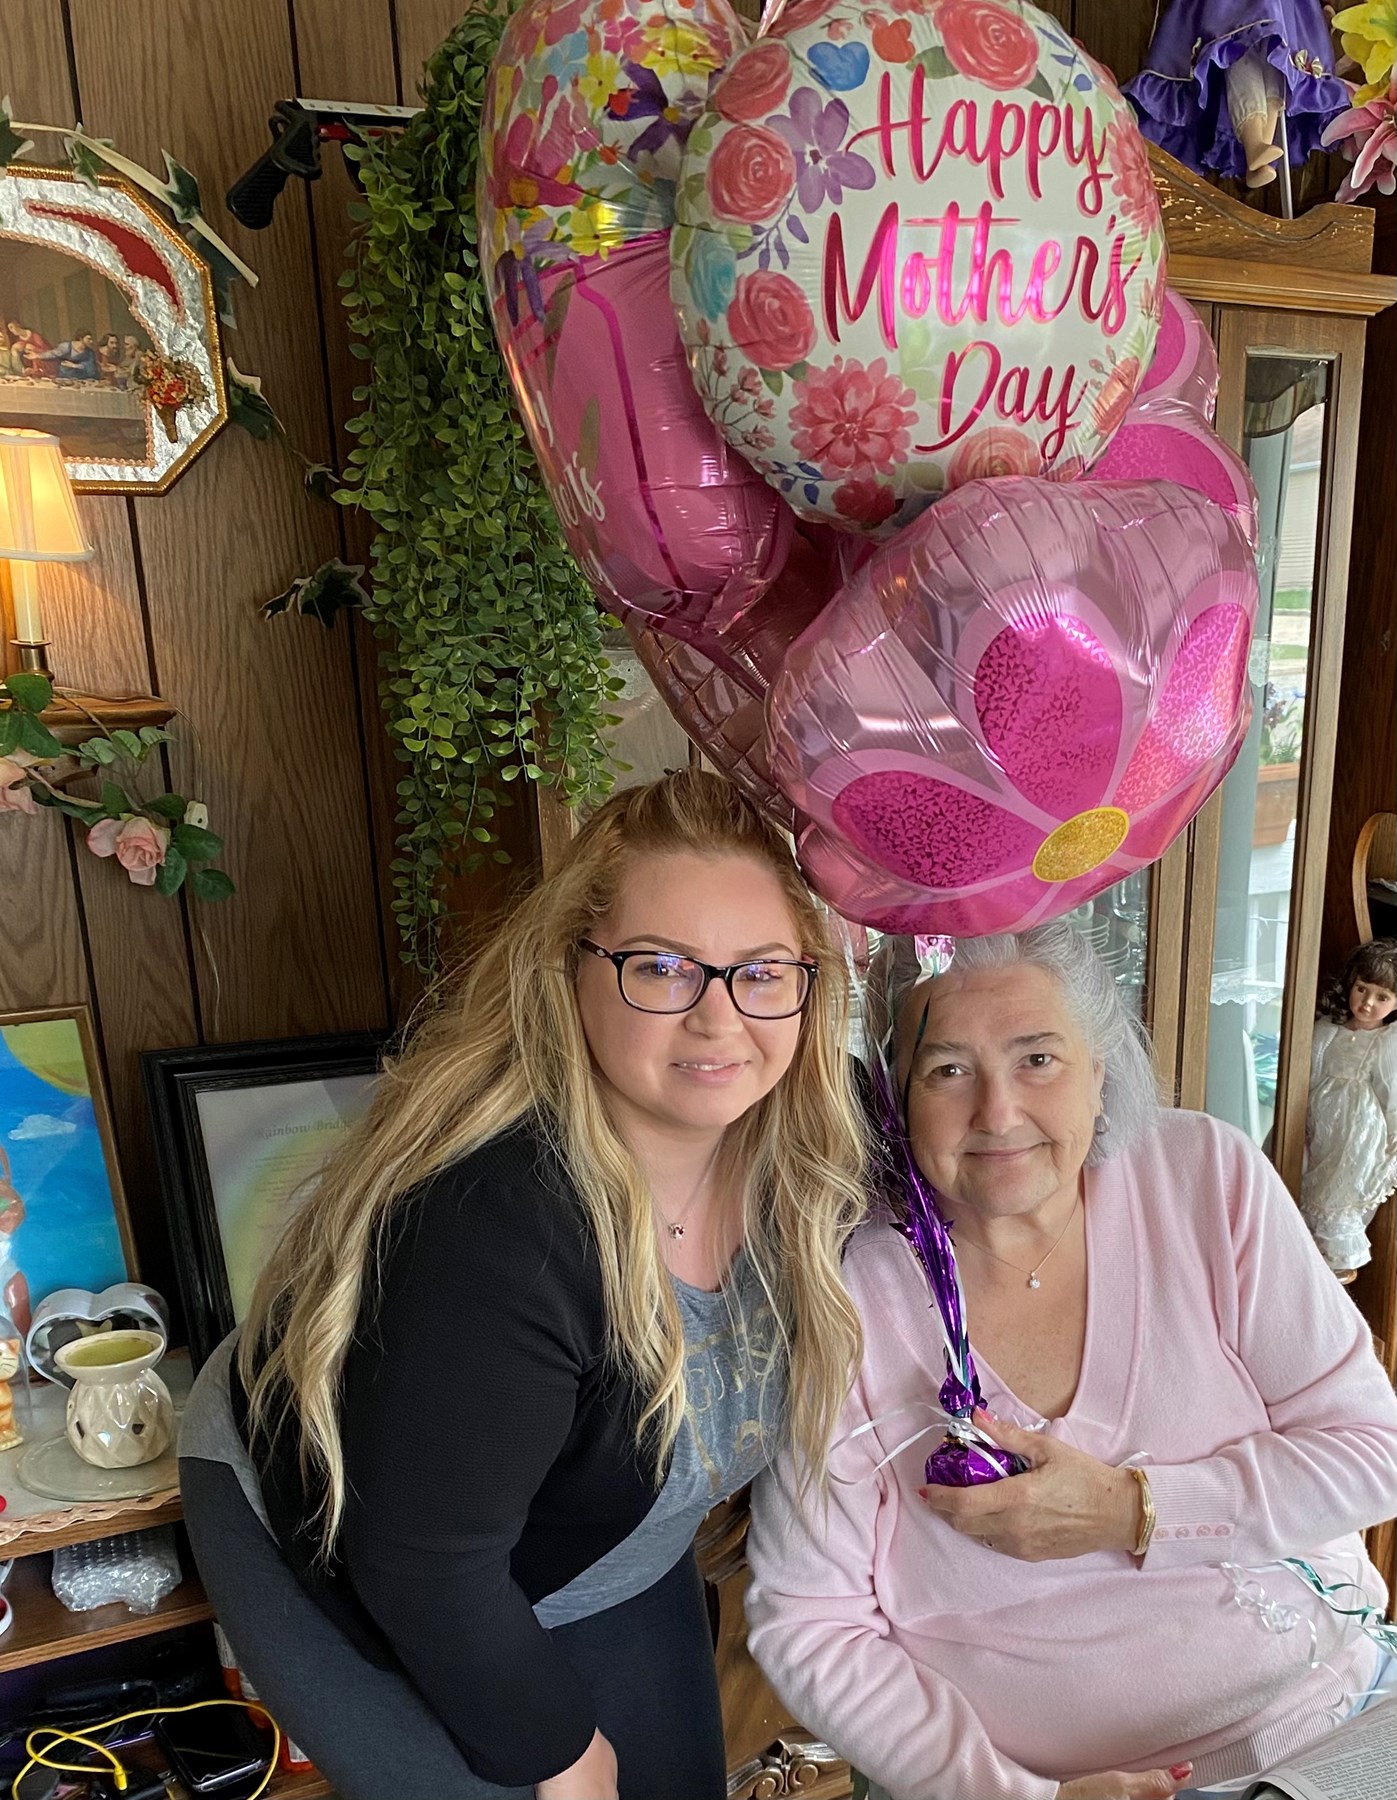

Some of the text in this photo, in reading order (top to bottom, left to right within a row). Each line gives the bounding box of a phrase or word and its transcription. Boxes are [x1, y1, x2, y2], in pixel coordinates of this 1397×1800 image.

[845, 64, 1113, 215] Happy
[822, 201, 1142, 349] Mother's
[914, 341, 1088, 460] Day
[254, 1123, 311, 1140] Rainbow
